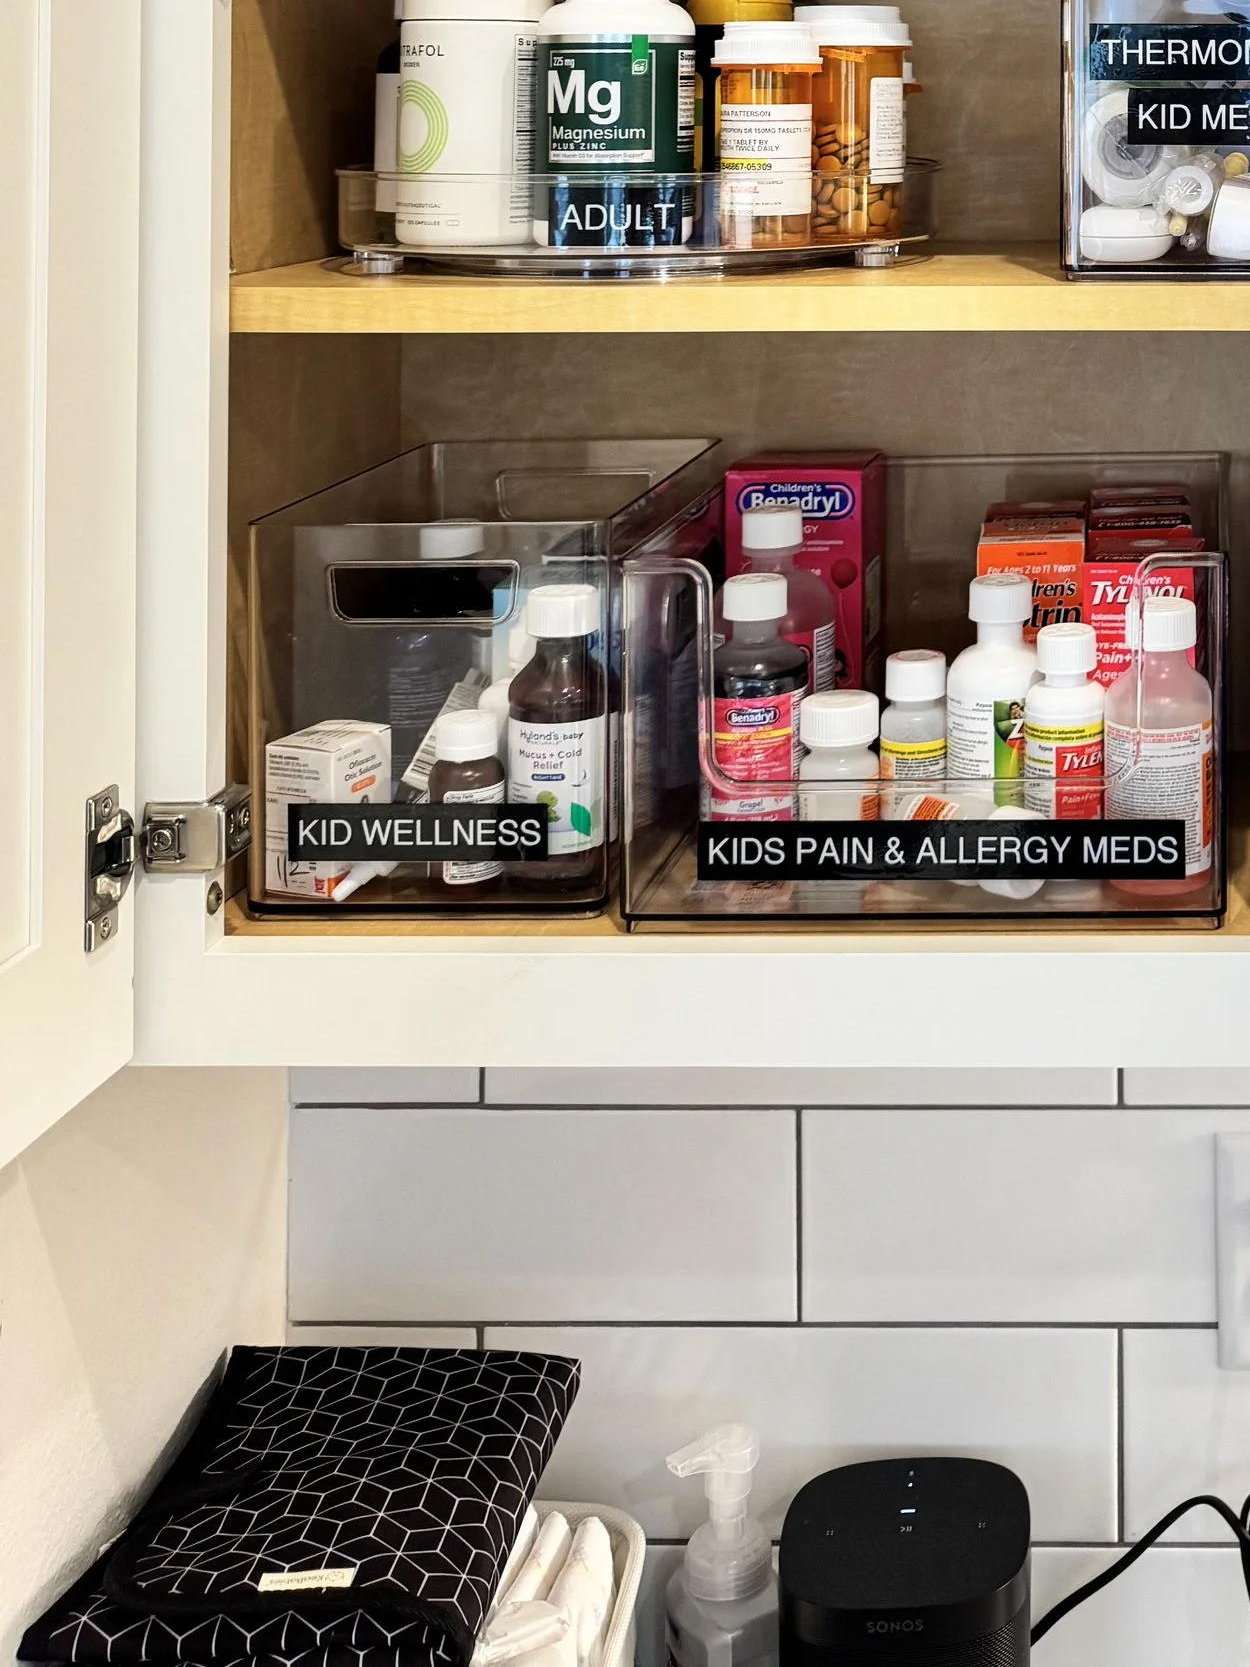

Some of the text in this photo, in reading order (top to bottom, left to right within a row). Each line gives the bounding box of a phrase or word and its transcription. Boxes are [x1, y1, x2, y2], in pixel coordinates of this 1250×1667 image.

[547, 69, 621, 125] Mg
[1137, 103, 1192, 131] KID
[552, 125, 646, 143] Magnesium
[552, 142, 607, 150] PLUS ZINC
[560, 203, 676, 232] ADULT
[769, 483, 822, 493] Children's
[1024, 565, 1031, 574] 2
[1032, 565, 1041, 573] to
[1042, 565, 1051, 573] 11
[1053, 564, 1077, 573] Years
[731, 710, 775, 723] Benadryl
[520, 729, 584, 743] Hyland's baby
[519, 749, 548, 759] Mucus
[557, 748, 583, 759] Cold
[533, 760, 564, 770] Relief
[298, 819, 542, 846] KID WELLNESS
[708, 836, 1179, 866] KIDS PAIN & ALLERGY MEDS
[866, 1619, 924, 1634] SONOS
